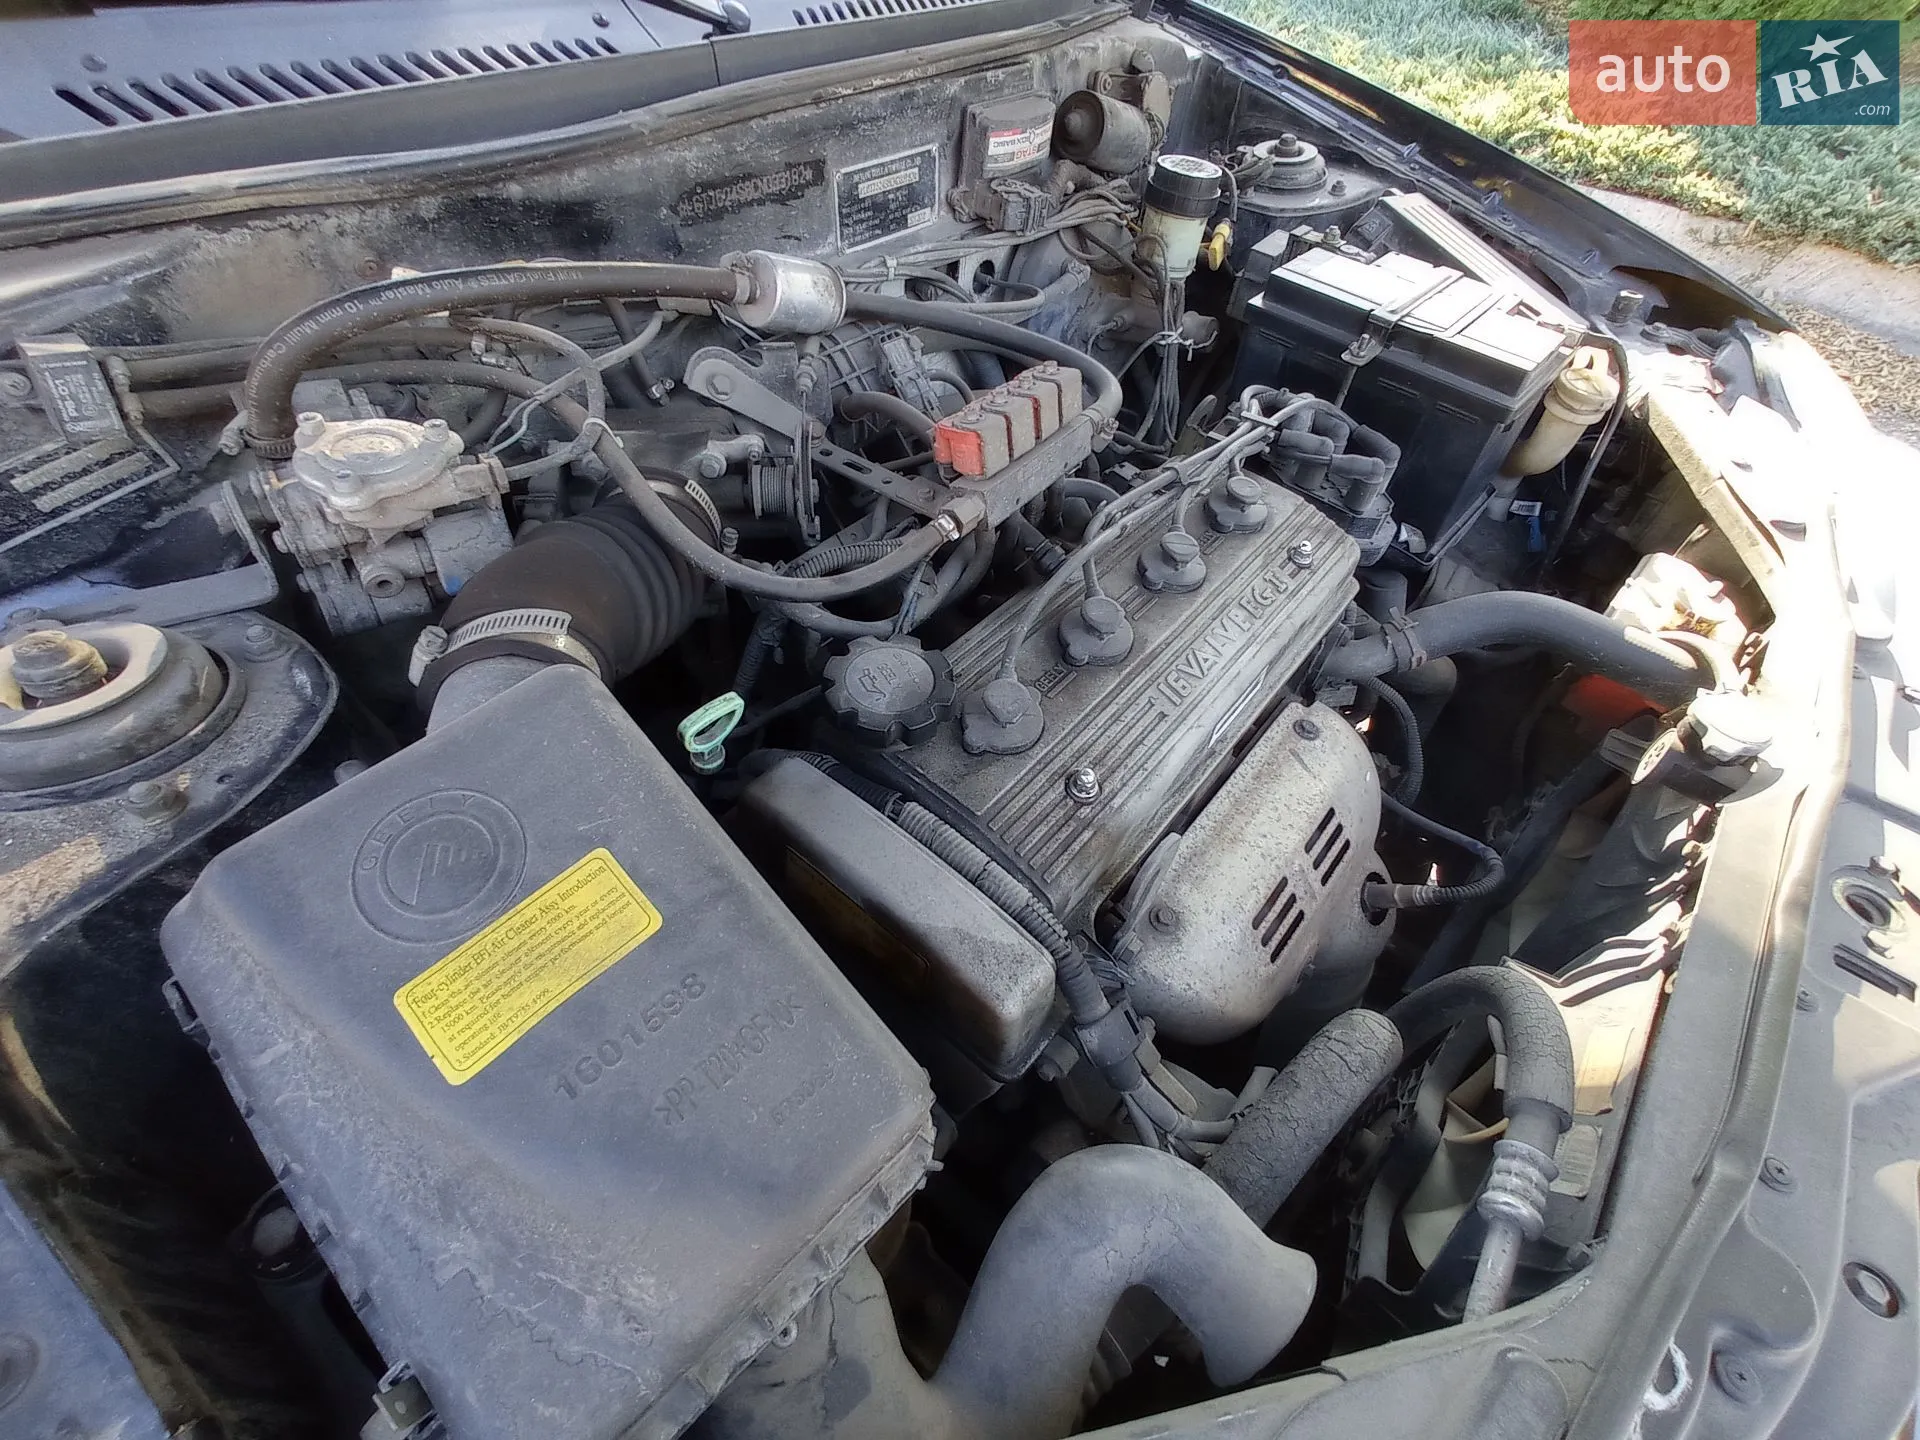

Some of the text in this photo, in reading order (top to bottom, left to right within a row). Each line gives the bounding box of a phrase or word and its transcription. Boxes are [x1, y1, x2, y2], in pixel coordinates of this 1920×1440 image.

[1015, 145, 1039, 159] STAG
[429, 279, 464, 294] Auto
[317, 307, 344, 326] mm
[346, 299, 364, 315] 10
[412, 958, 475, 1011] Four-cylinder
[487, 935, 507, 953] Air
[503, 911, 539, 941] Cleaner
[536, 896, 561, 919] Assy
[556, 861, 606, 903] Introduction
[527, 924, 548, 942] every
[545, 911, 564, 928] 5000
[466, 985, 482, 1000] the
[480, 977, 493, 989] air
[523, 932, 554, 957] element
[553, 918, 574, 936] every
[573, 904, 593, 921] year
[598, 884, 619, 902] every
[454, 1007, 490, 1037] required
[487, 997, 502, 1010] for
[547, 927, 595, 965] performance
[606, 899, 633, 921] longest
[439, 1012, 464, 1033] 15000
[452, 1021, 491, 1053] operating
